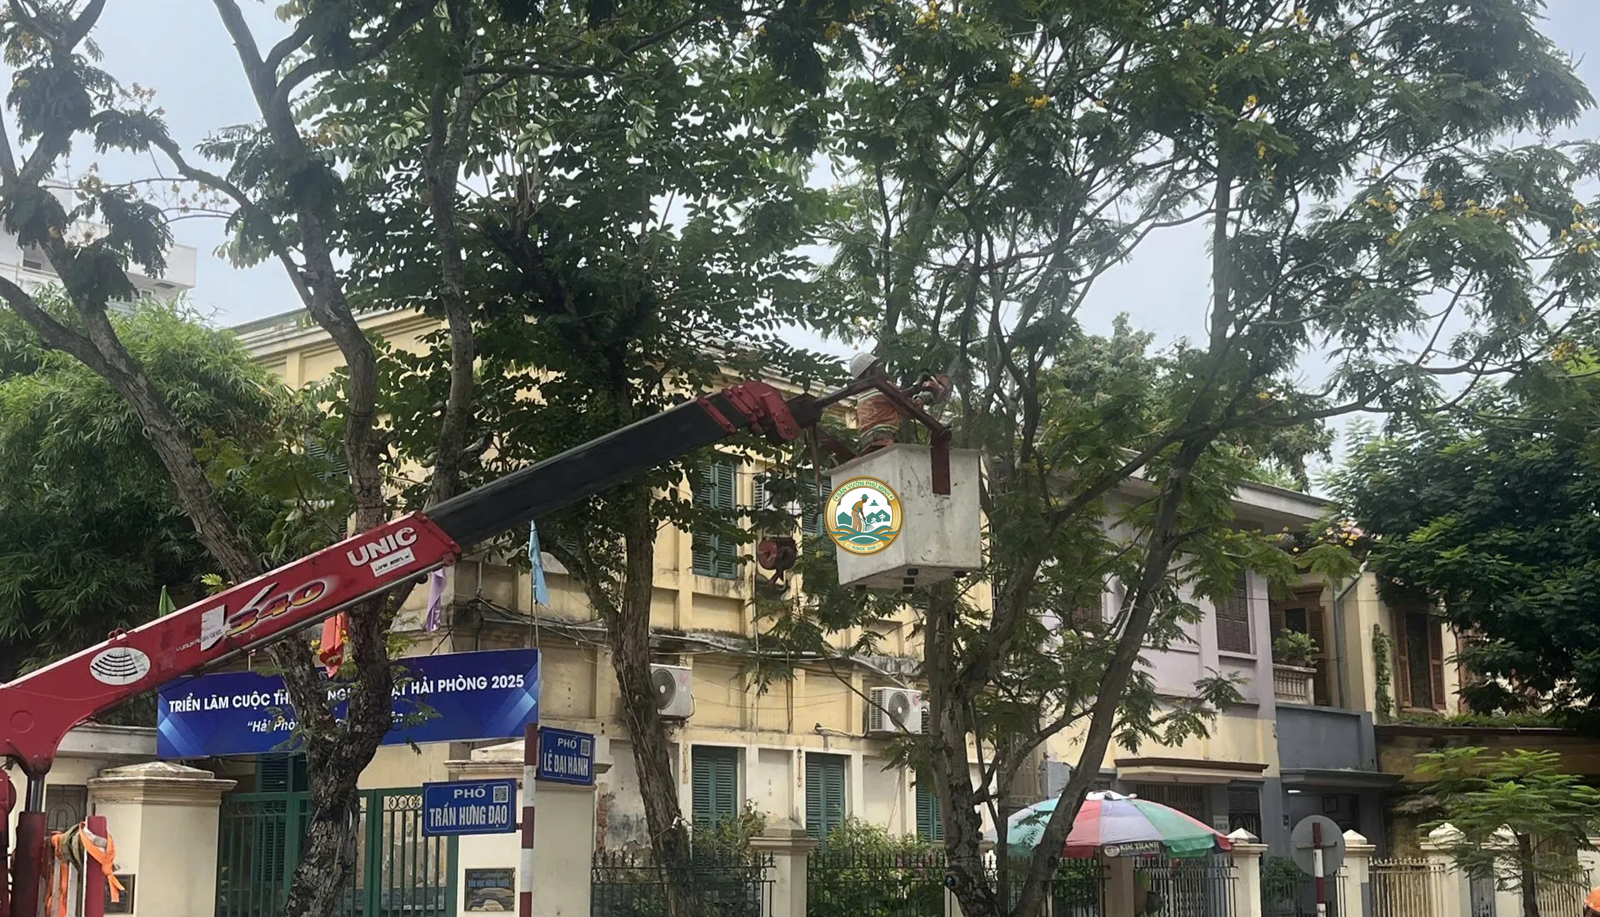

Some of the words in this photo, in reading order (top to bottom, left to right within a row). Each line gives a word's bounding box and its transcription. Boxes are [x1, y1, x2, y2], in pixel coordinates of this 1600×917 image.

[346, 527, 417, 566] UNIC
[169, 692, 200, 713] TRIỂN
[204, 694, 229, 710] LÃM
[232, 691, 270, 710] CUỘC
[274, 692, 292, 706] TH
[411, 676, 434, 695] HẢI
[438, 674, 488, 693] PHÒNG
[491, 674, 525, 688] 2025
[557, 735, 577, 749] PHỐ
[543, 749, 553, 772] LÊ
[554, 754, 567, 777] ĐẠI
[567, 753, 589, 777] HÀNH
[453, 784, 486, 799] PHỐ
[459, 804, 486, 826] HƯNG
[488, 804, 508, 828] ĐẠO
